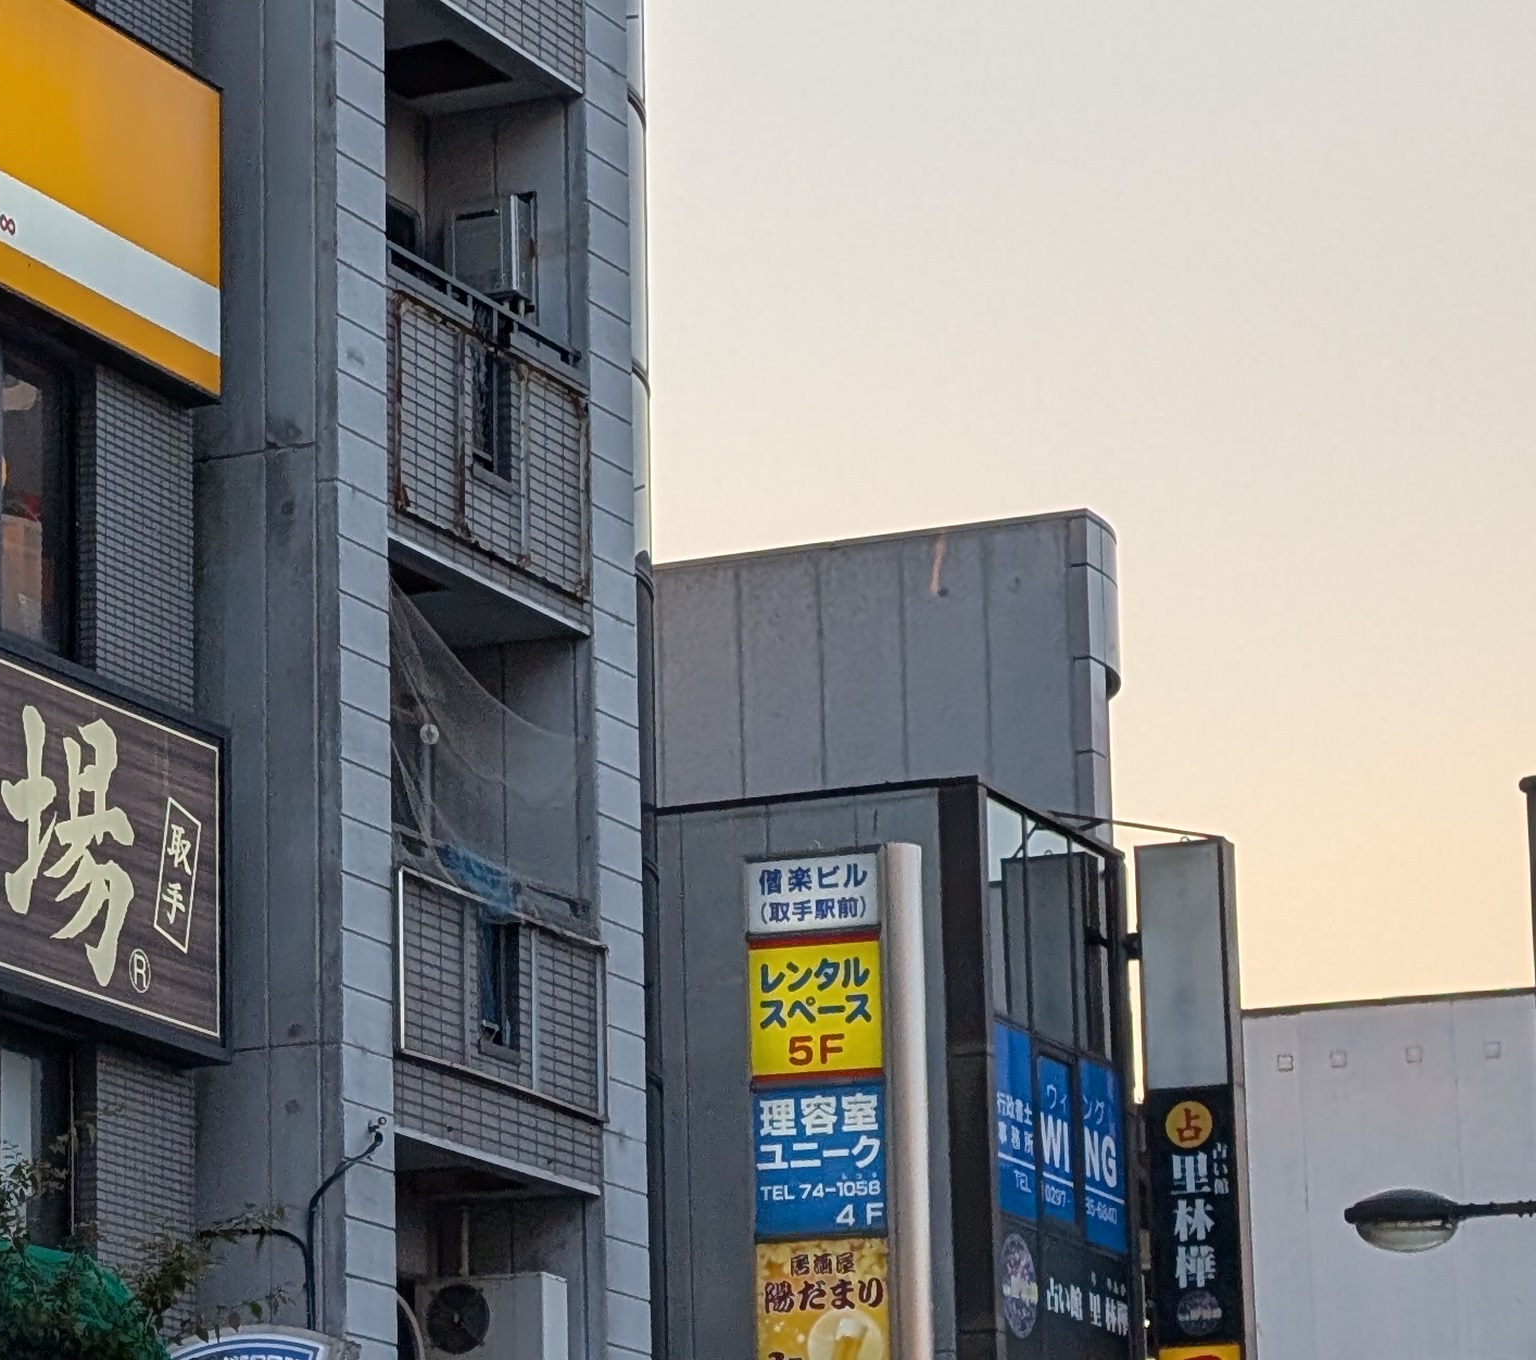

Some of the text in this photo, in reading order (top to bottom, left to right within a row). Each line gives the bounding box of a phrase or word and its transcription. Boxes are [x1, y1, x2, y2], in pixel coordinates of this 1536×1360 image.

[160, 823, 194, 926] 取手
[760, 895, 867, 925] (取手駅前)
[760, 956, 870, 994] レンタル
[759, 993, 872, 1030] スペース
[788, 1033, 845, 1066] 5F
[759, 1093, 879, 1137] 理容室
[1175, 1107, 1203, 1143] 占
[755, 1134, 881, 1171] ユニーク
[1040, 1111, 1118, 1188] WING
[760, 1179, 882, 1202] TEL 74-1058
[789, 1251, 856, 1277] 居酒屋
[763, 1276, 885, 1315] 陽だまり
